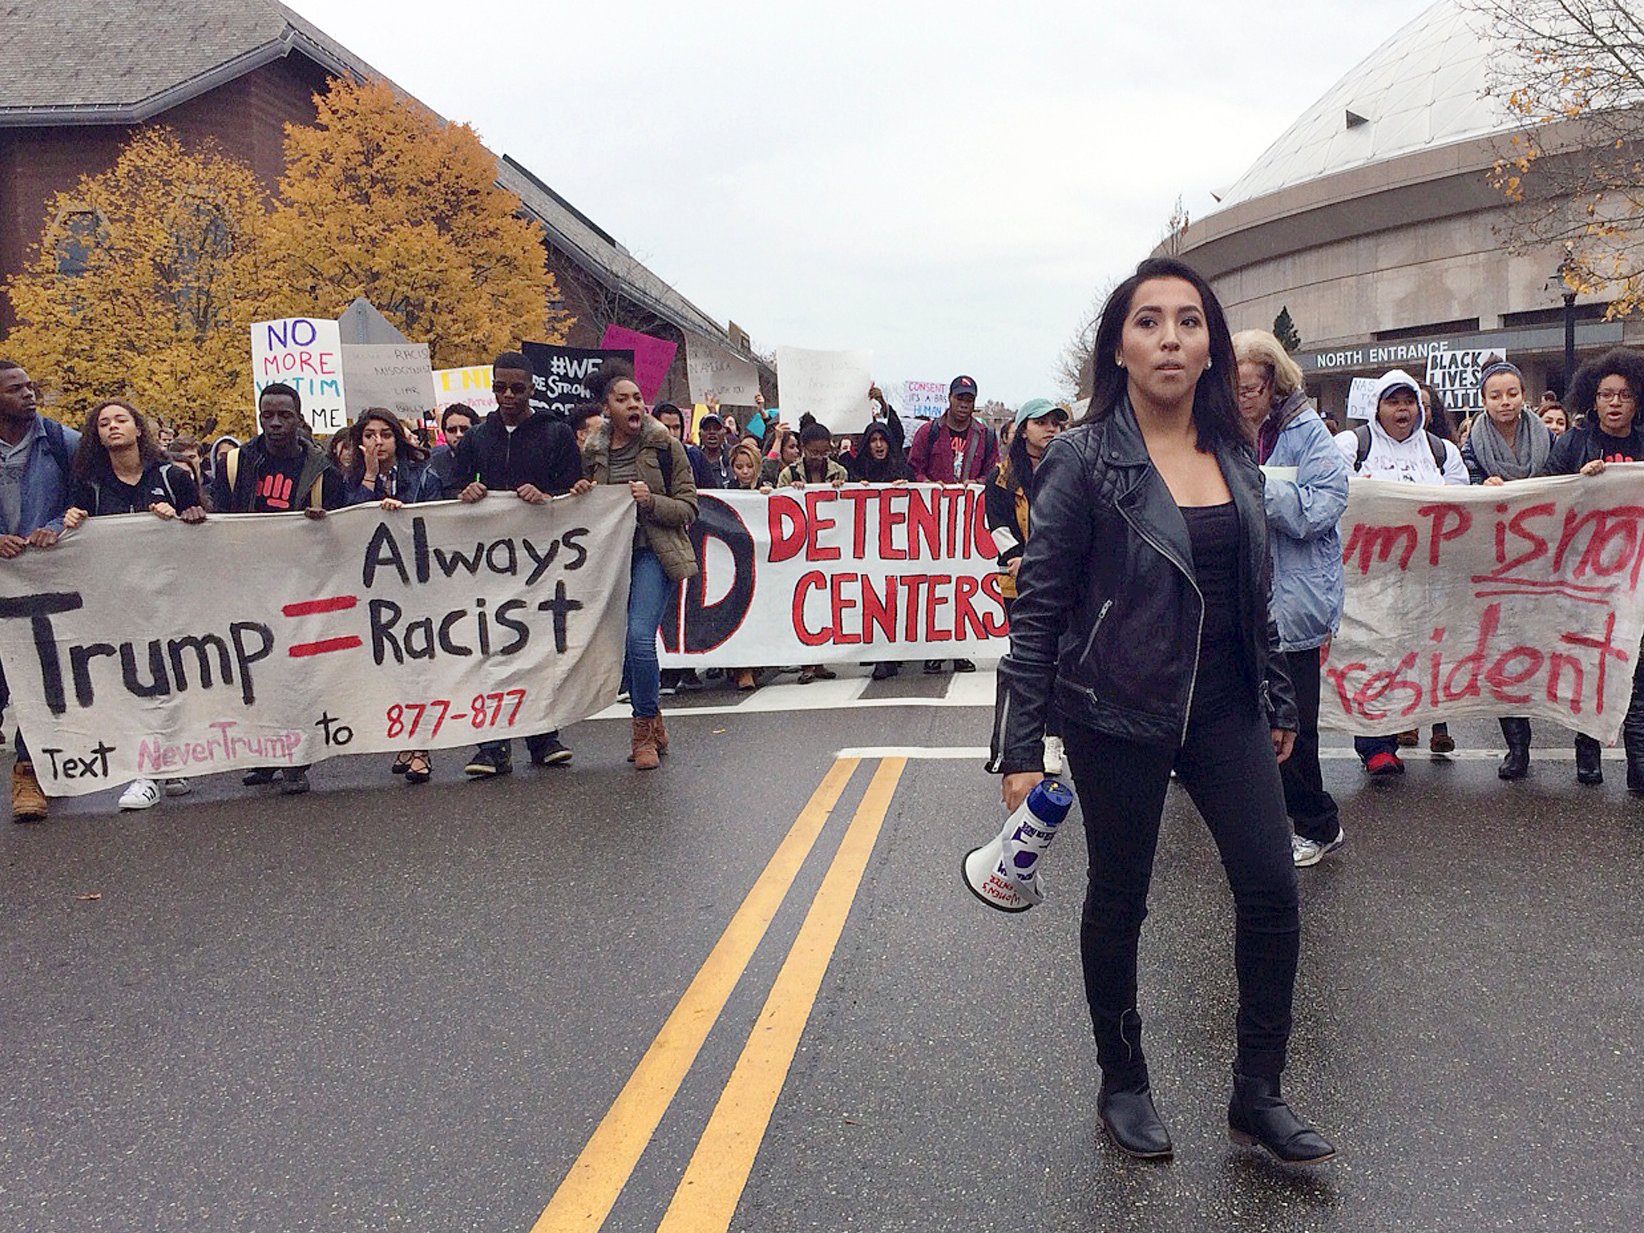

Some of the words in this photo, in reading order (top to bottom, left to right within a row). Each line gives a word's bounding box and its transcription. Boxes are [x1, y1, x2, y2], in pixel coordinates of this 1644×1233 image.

[268, 319, 317, 351] NO
[264, 351, 336, 376] MORE
[1317, 350, 1362, 368] NORTH
[1369, 341, 1449, 363] ENTRANCE
[1430, 351, 1482, 371] BLACK
[550, 355, 603, 379] #WE
[1429, 369, 1480, 388] LIVES
[256, 377, 340, 398] VTIM
[547, 375, 594, 399] STRON
[1438, 389, 1484, 408] ATT
[312, 408, 341, 429] ME
[363, 517, 590, 588] Always
[792, 570, 1009, 646] CENTERS
[0, 591, 274, 717] Trump
[368, 579, 583, 666] Racist
[41, 741, 116, 780] Text
[138, 721, 301, 772] NeverTrump
[315, 710, 353, 746] to
[386, 688, 526, 740] 877-877
